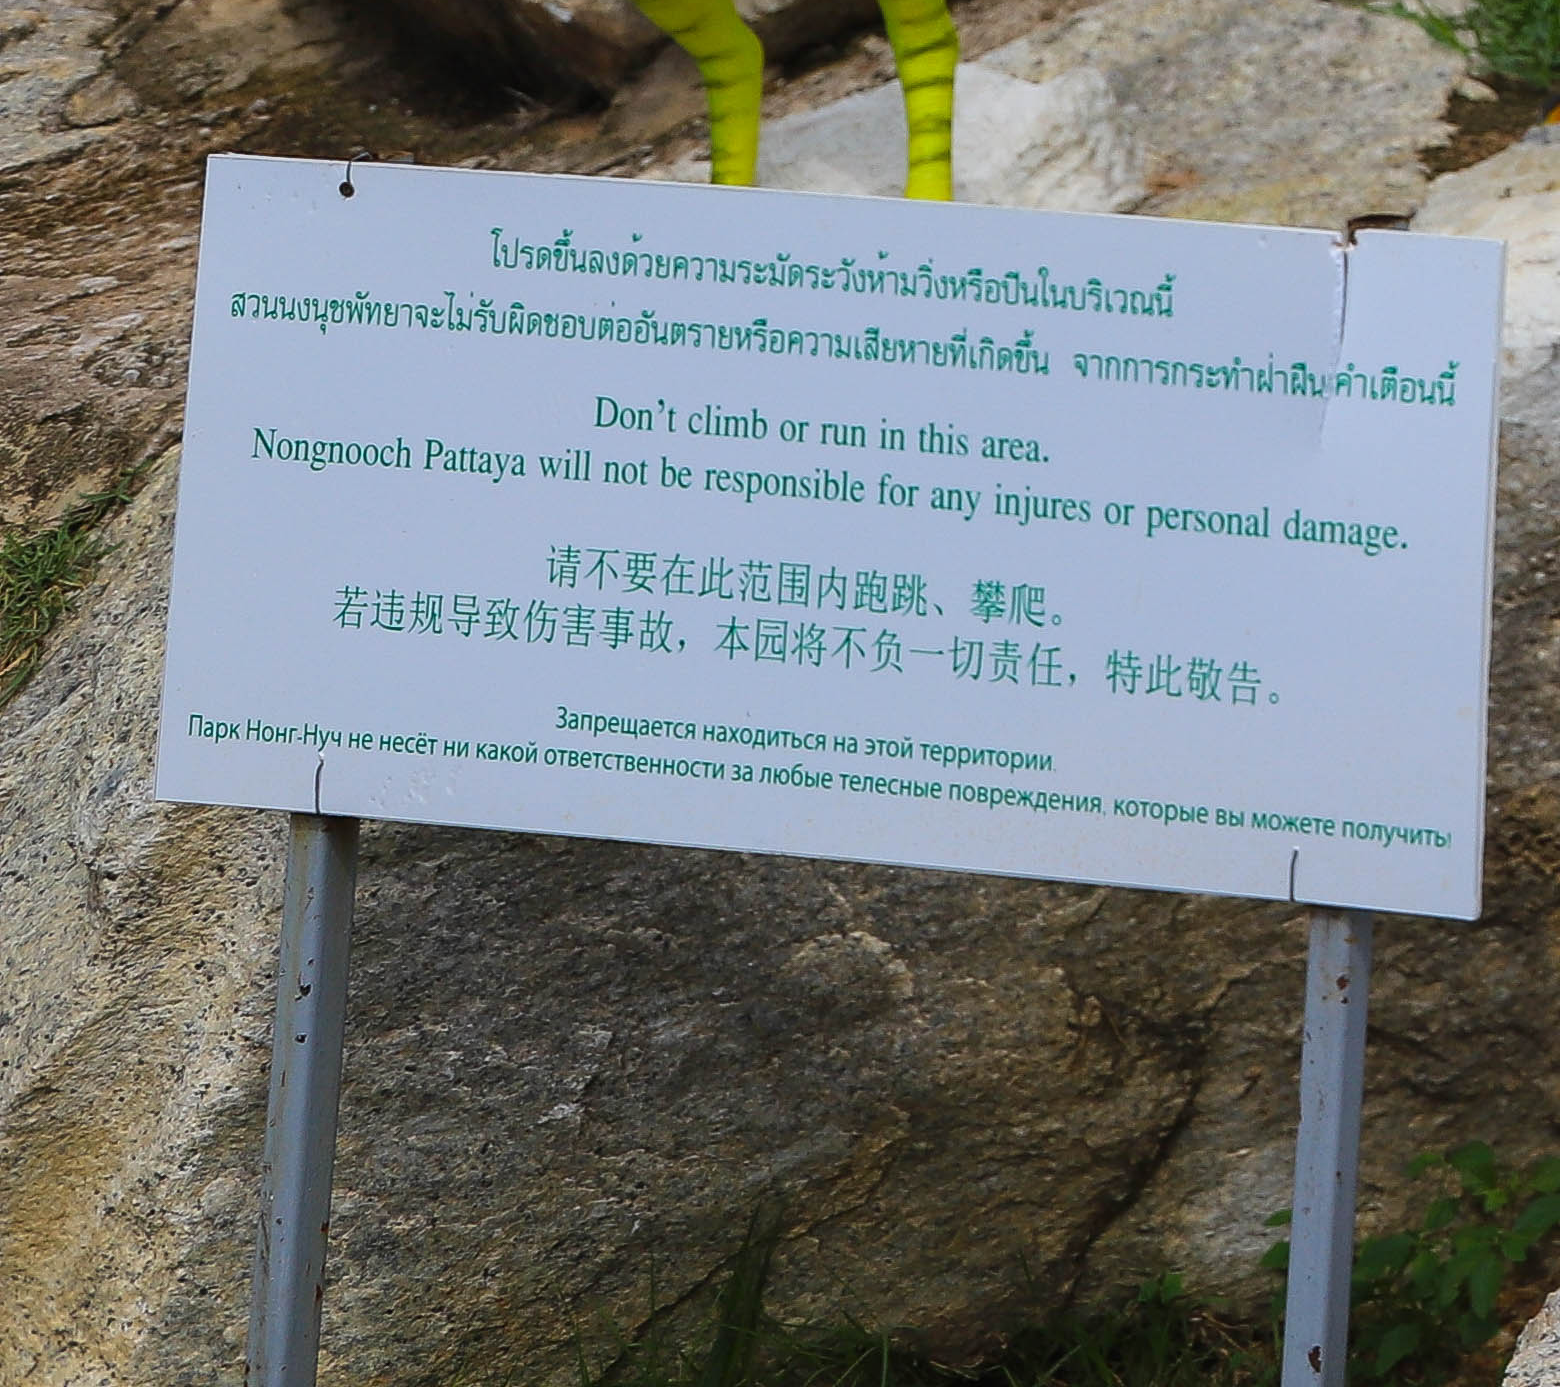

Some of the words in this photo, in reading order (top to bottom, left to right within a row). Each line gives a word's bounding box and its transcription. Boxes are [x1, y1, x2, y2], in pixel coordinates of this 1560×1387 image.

[594, 395, 677, 431] Don’t
[689, 405, 769, 438] climb
[780, 421, 809, 441] or
[820, 424, 868, 447] run
[878, 419, 910, 449] in
[917, 423, 970, 457] this
[981, 437, 1051, 463] area.
[252, 429, 410, 469] Nongnooch
[425, 437, 524, 482] Pattaya
[539, 448, 590, 481] will
[603, 461, 650, 484] not
[660, 457, 693, 487] be
[705, 469, 866, 502] responsible
[875, 473, 920, 506] for
[931, 488, 982, 521] any
[994, 485, 1092, 525] injures
[1104, 504, 1134, 526] or
[1145, 505, 1269, 537] personal
[1283, 509, 1406, 555] damage.
[546, 545, 1062, 625] 请不要在此范围内跑跳、攀爬。
[335, 584, 1278, 705] 若违规导致伤害事故，本园将不负一切责任，特此敬告。
[189, 716, 238, 742] Парк
[247, 719, 343, 745] Нонг-Нуч
[348, 732, 372, 752] не
[378, 732, 436, 755] несёт
[442, 741, 468, 756] ни
[477, 741, 536, 761] какой
[542, 749, 726, 779] ответственности
[731, 763, 754, 782] за
[759, 760, 831, 788] любые
[836, 775, 942, 797] телесные
[1114, 799, 1208, 823] которые
[1216, 809, 1244, 825] вы
[1250, 813, 1334, 835] можете
[554, 705, 698, 737] Запрещается
[703, 725, 829, 751] находиться
[833, 734, 859, 753] на
[863, 737, 913, 758] этой
